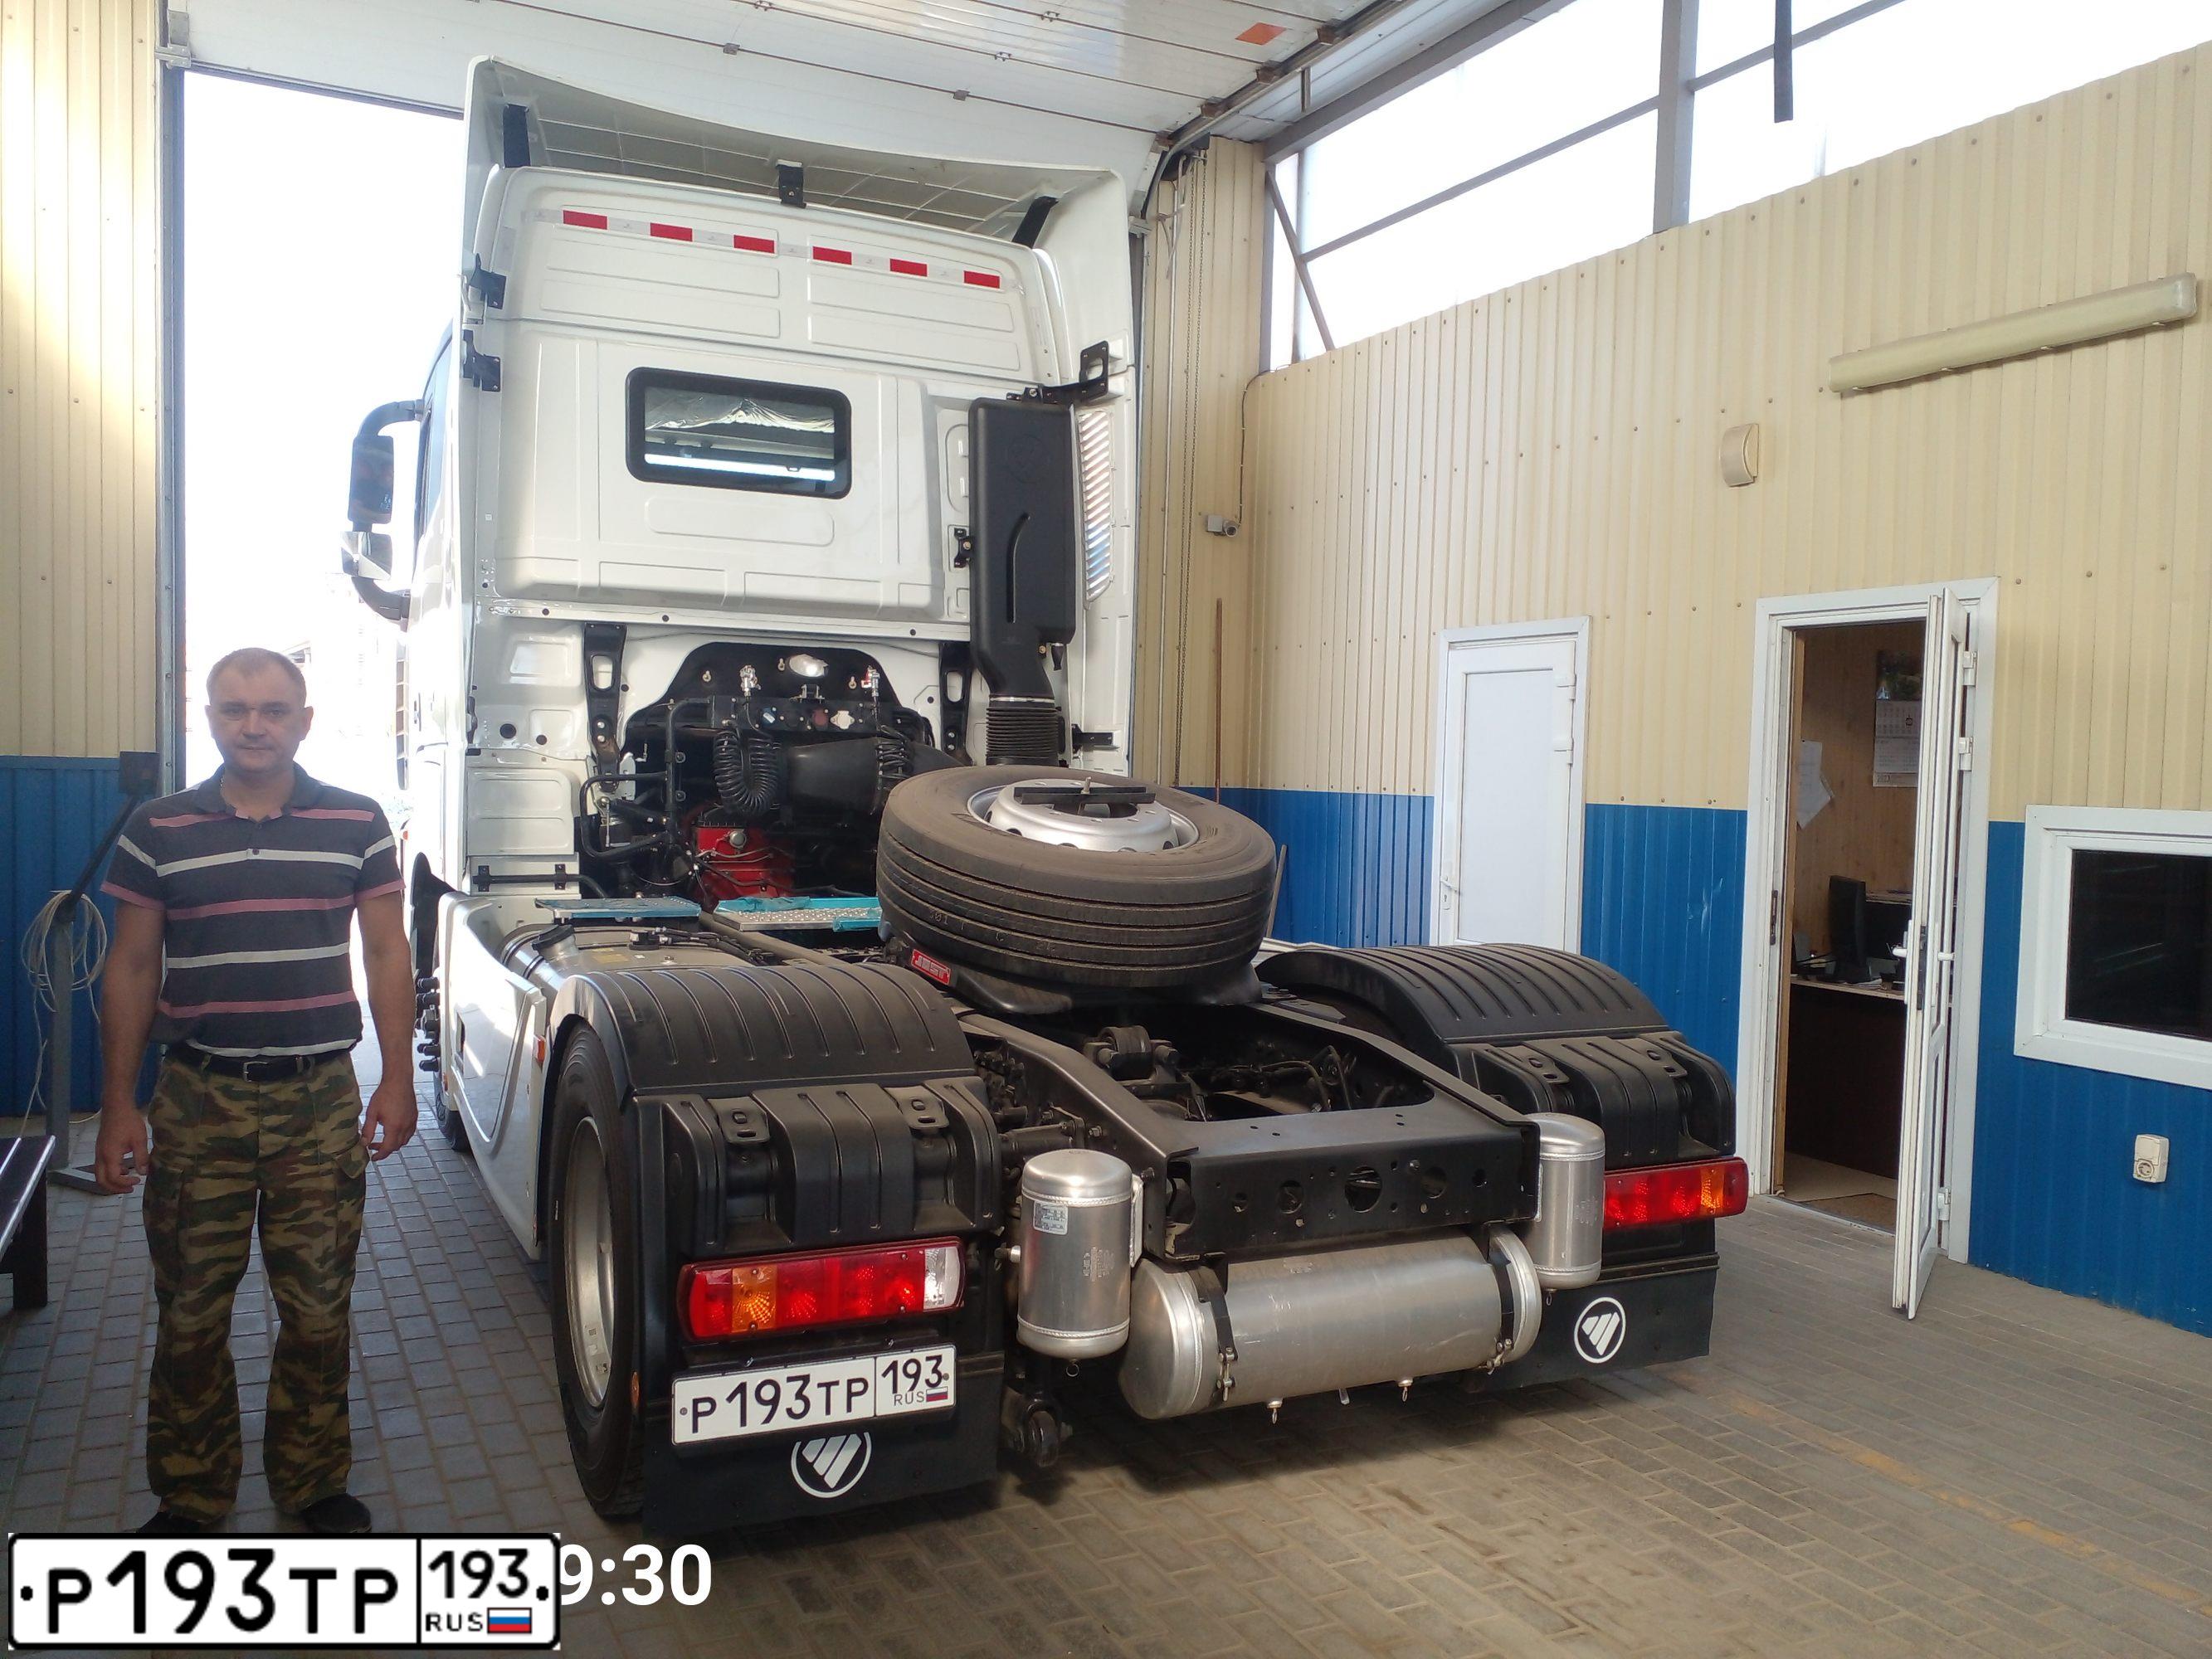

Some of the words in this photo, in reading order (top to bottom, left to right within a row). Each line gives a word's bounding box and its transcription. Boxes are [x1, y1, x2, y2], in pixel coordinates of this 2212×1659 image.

[914, 955, 947, 980] JOST
[881, 1354, 943, 1394] 193
[894, 1391, 925, 1406] RUS
